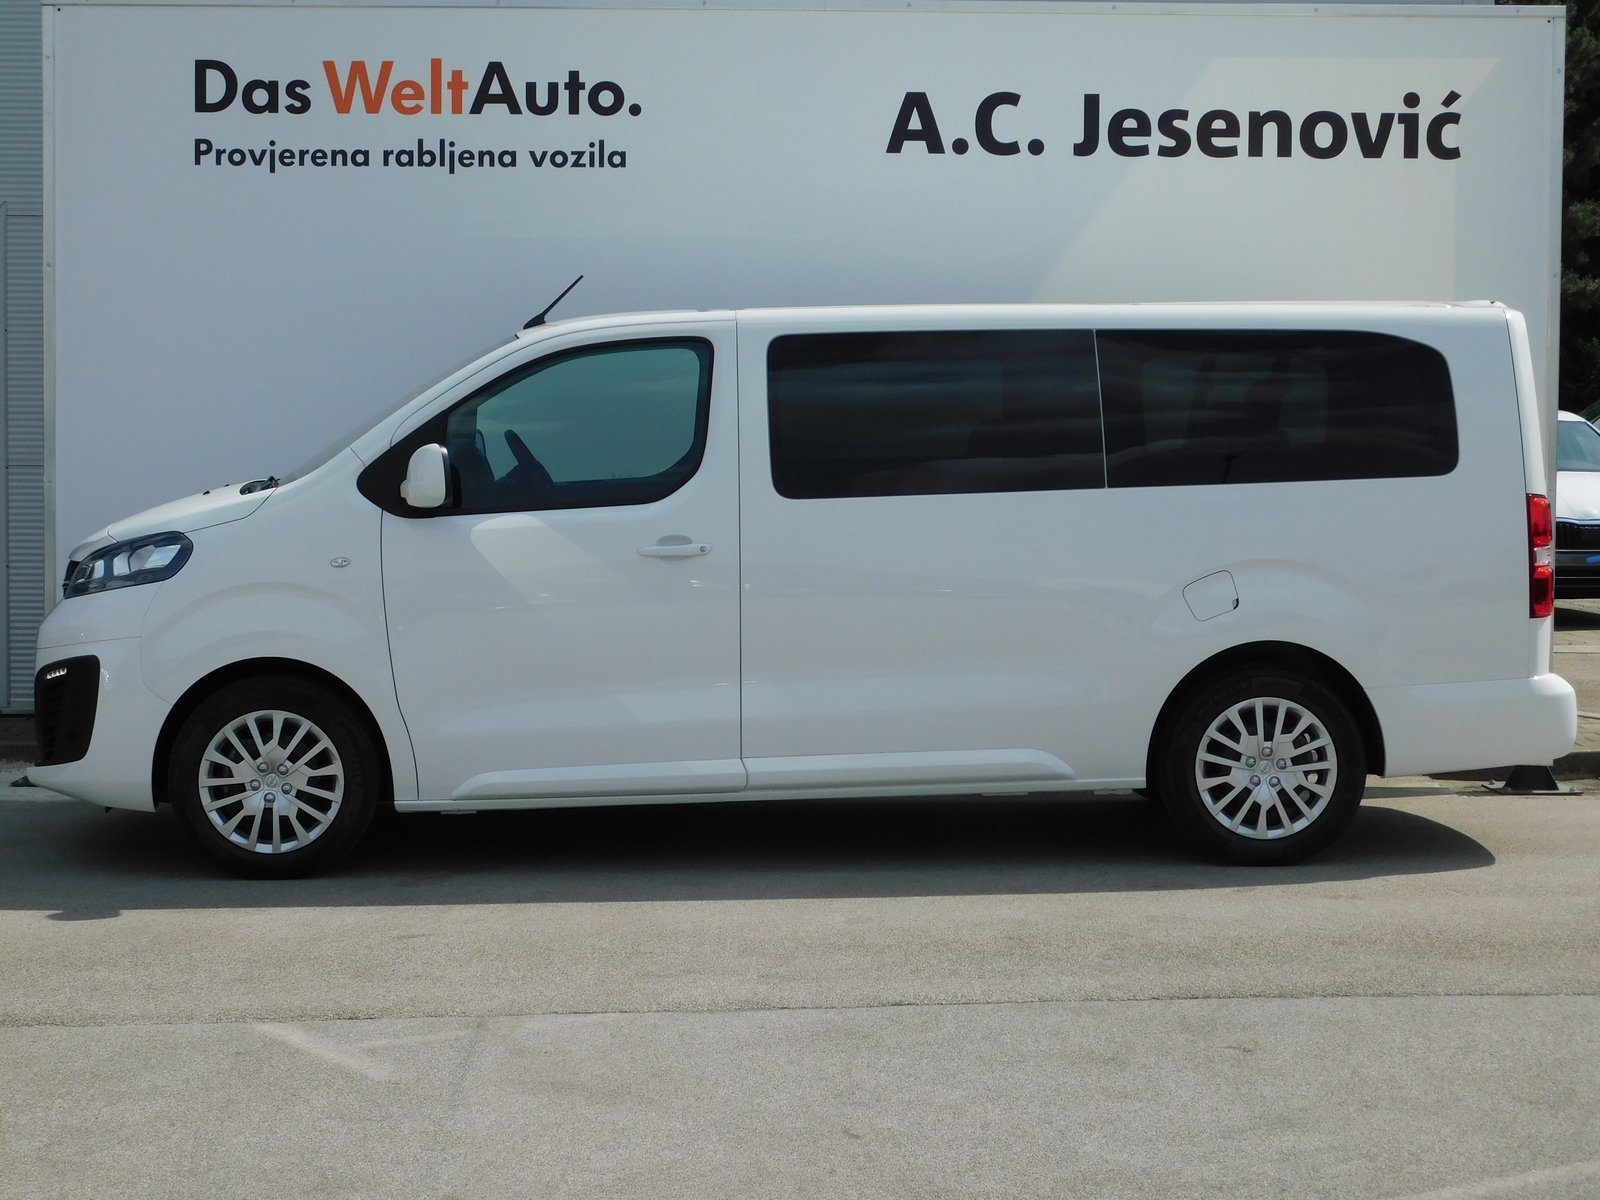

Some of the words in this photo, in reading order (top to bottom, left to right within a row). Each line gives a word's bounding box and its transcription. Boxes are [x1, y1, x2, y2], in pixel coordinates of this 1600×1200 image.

[194, 58, 312, 115] Das
[322, 57, 642, 117] WeltAuto.
[885, 91, 1045, 157] A.C.
[1072, 90, 1462, 161] Jesenović
[194, 138, 370, 174] Provjerena
[382, 137, 517, 175] rabljena
[528, 139, 627, 169] vozila
